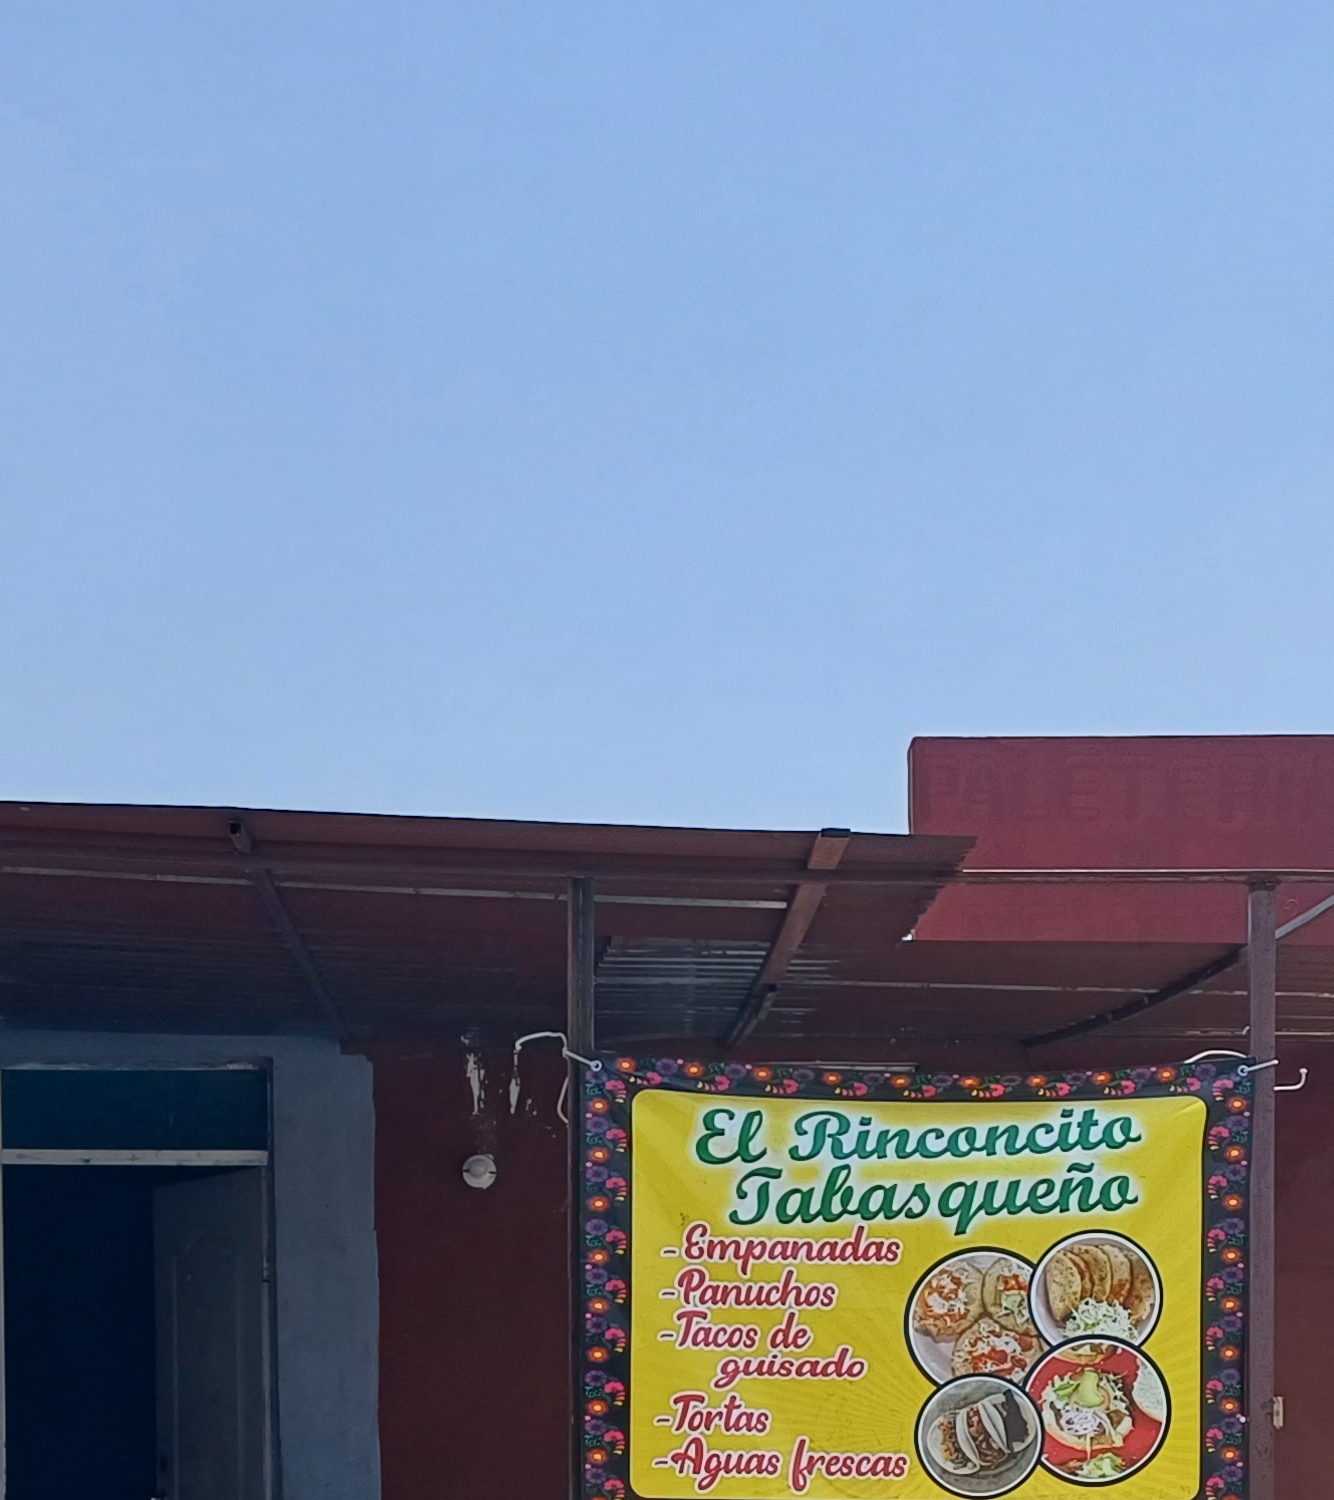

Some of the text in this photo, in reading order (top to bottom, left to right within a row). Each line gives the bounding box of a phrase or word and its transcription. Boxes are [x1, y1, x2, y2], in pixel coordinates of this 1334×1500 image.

[696, 1108, 1142, 1164] El Rinconcito
[728, 1162, 1138, 1235] Tabasqueño
[770, 1312, 810, 1349] de
[713, 1348, 866, 1389] guisado
[792, 1439, 907, 1492] frescas
